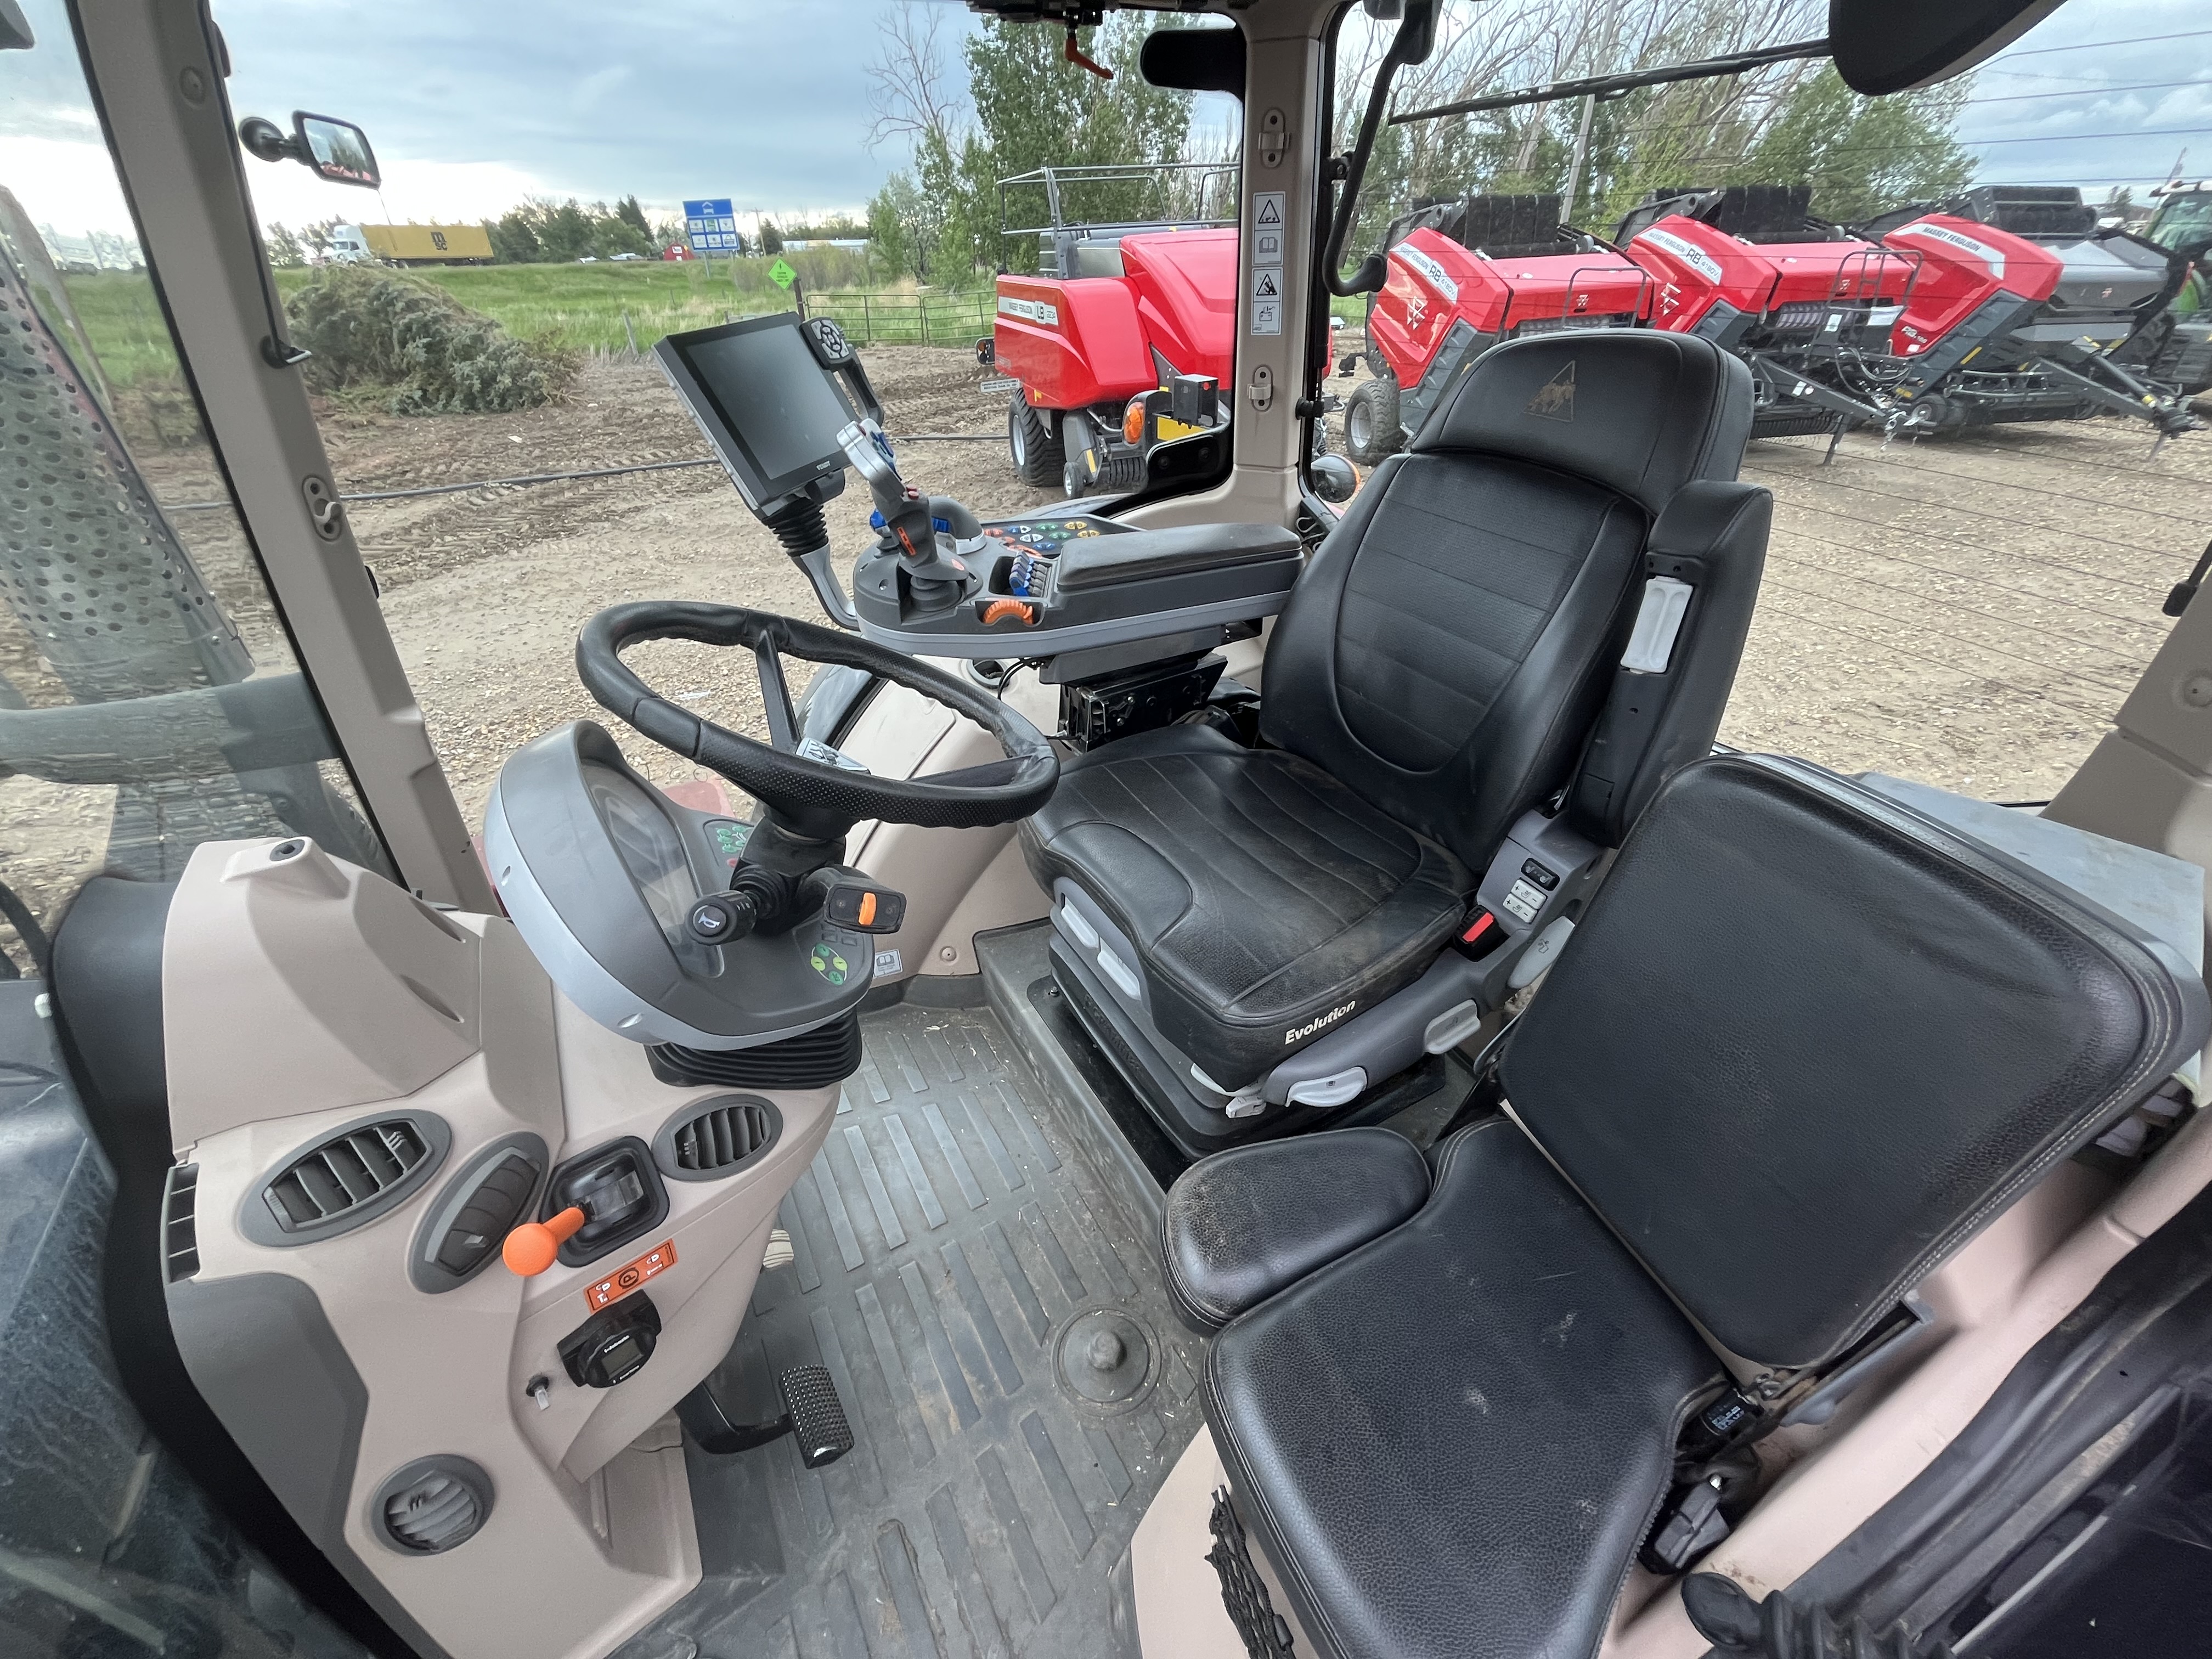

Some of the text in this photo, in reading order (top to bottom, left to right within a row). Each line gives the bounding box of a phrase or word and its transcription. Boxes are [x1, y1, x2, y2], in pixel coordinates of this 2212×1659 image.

[1664, 238, 1686, 253] FERGUSON
[1686, 248, 1701, 264] RB
[1923, 227, 1982, 252] MASSEY FERGUSON
[1429, 264, 1442, 282] RB
[1285, 1001, 1356, 1045] Evolution
